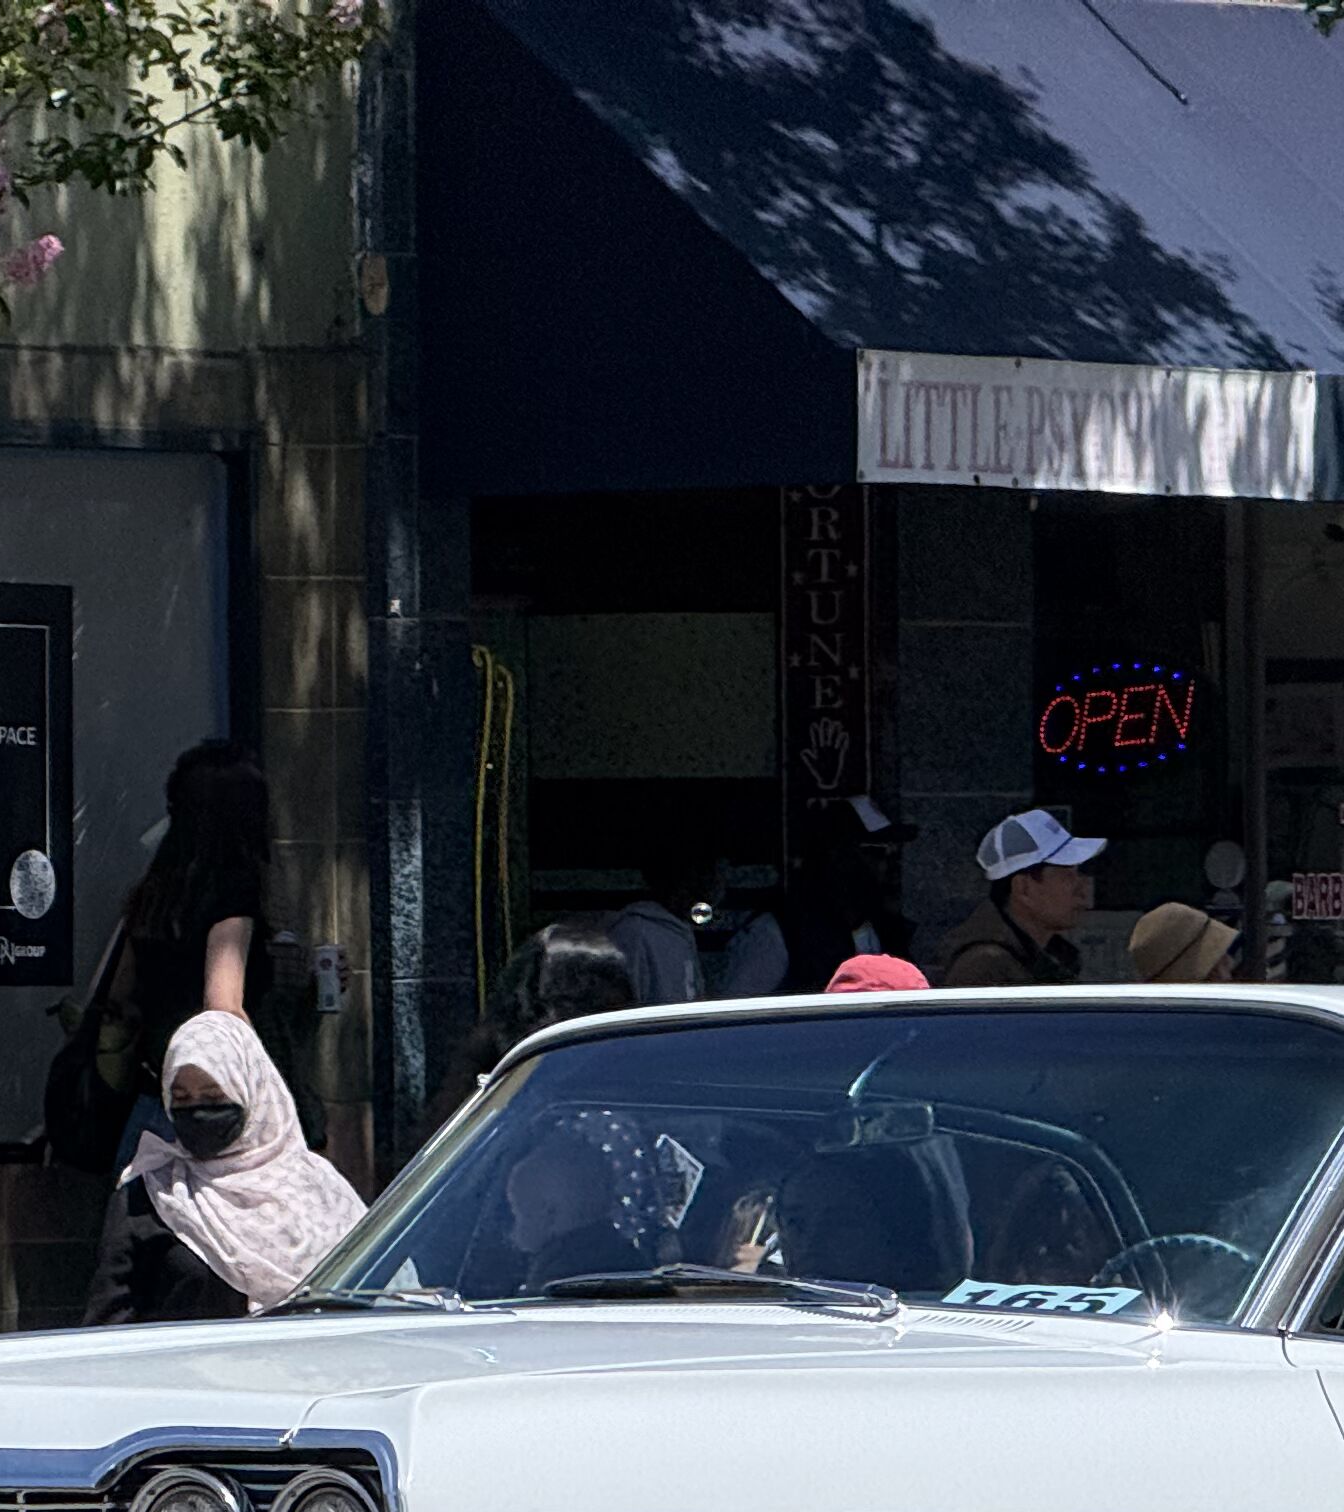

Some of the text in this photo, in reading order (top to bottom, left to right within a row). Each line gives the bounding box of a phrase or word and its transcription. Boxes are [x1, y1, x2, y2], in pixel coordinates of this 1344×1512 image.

[876, 379, 1012, 474] LITTLE
[1040, 679, 1196, 754] OPEN
[964, 1289, 1120, 1314] 165
